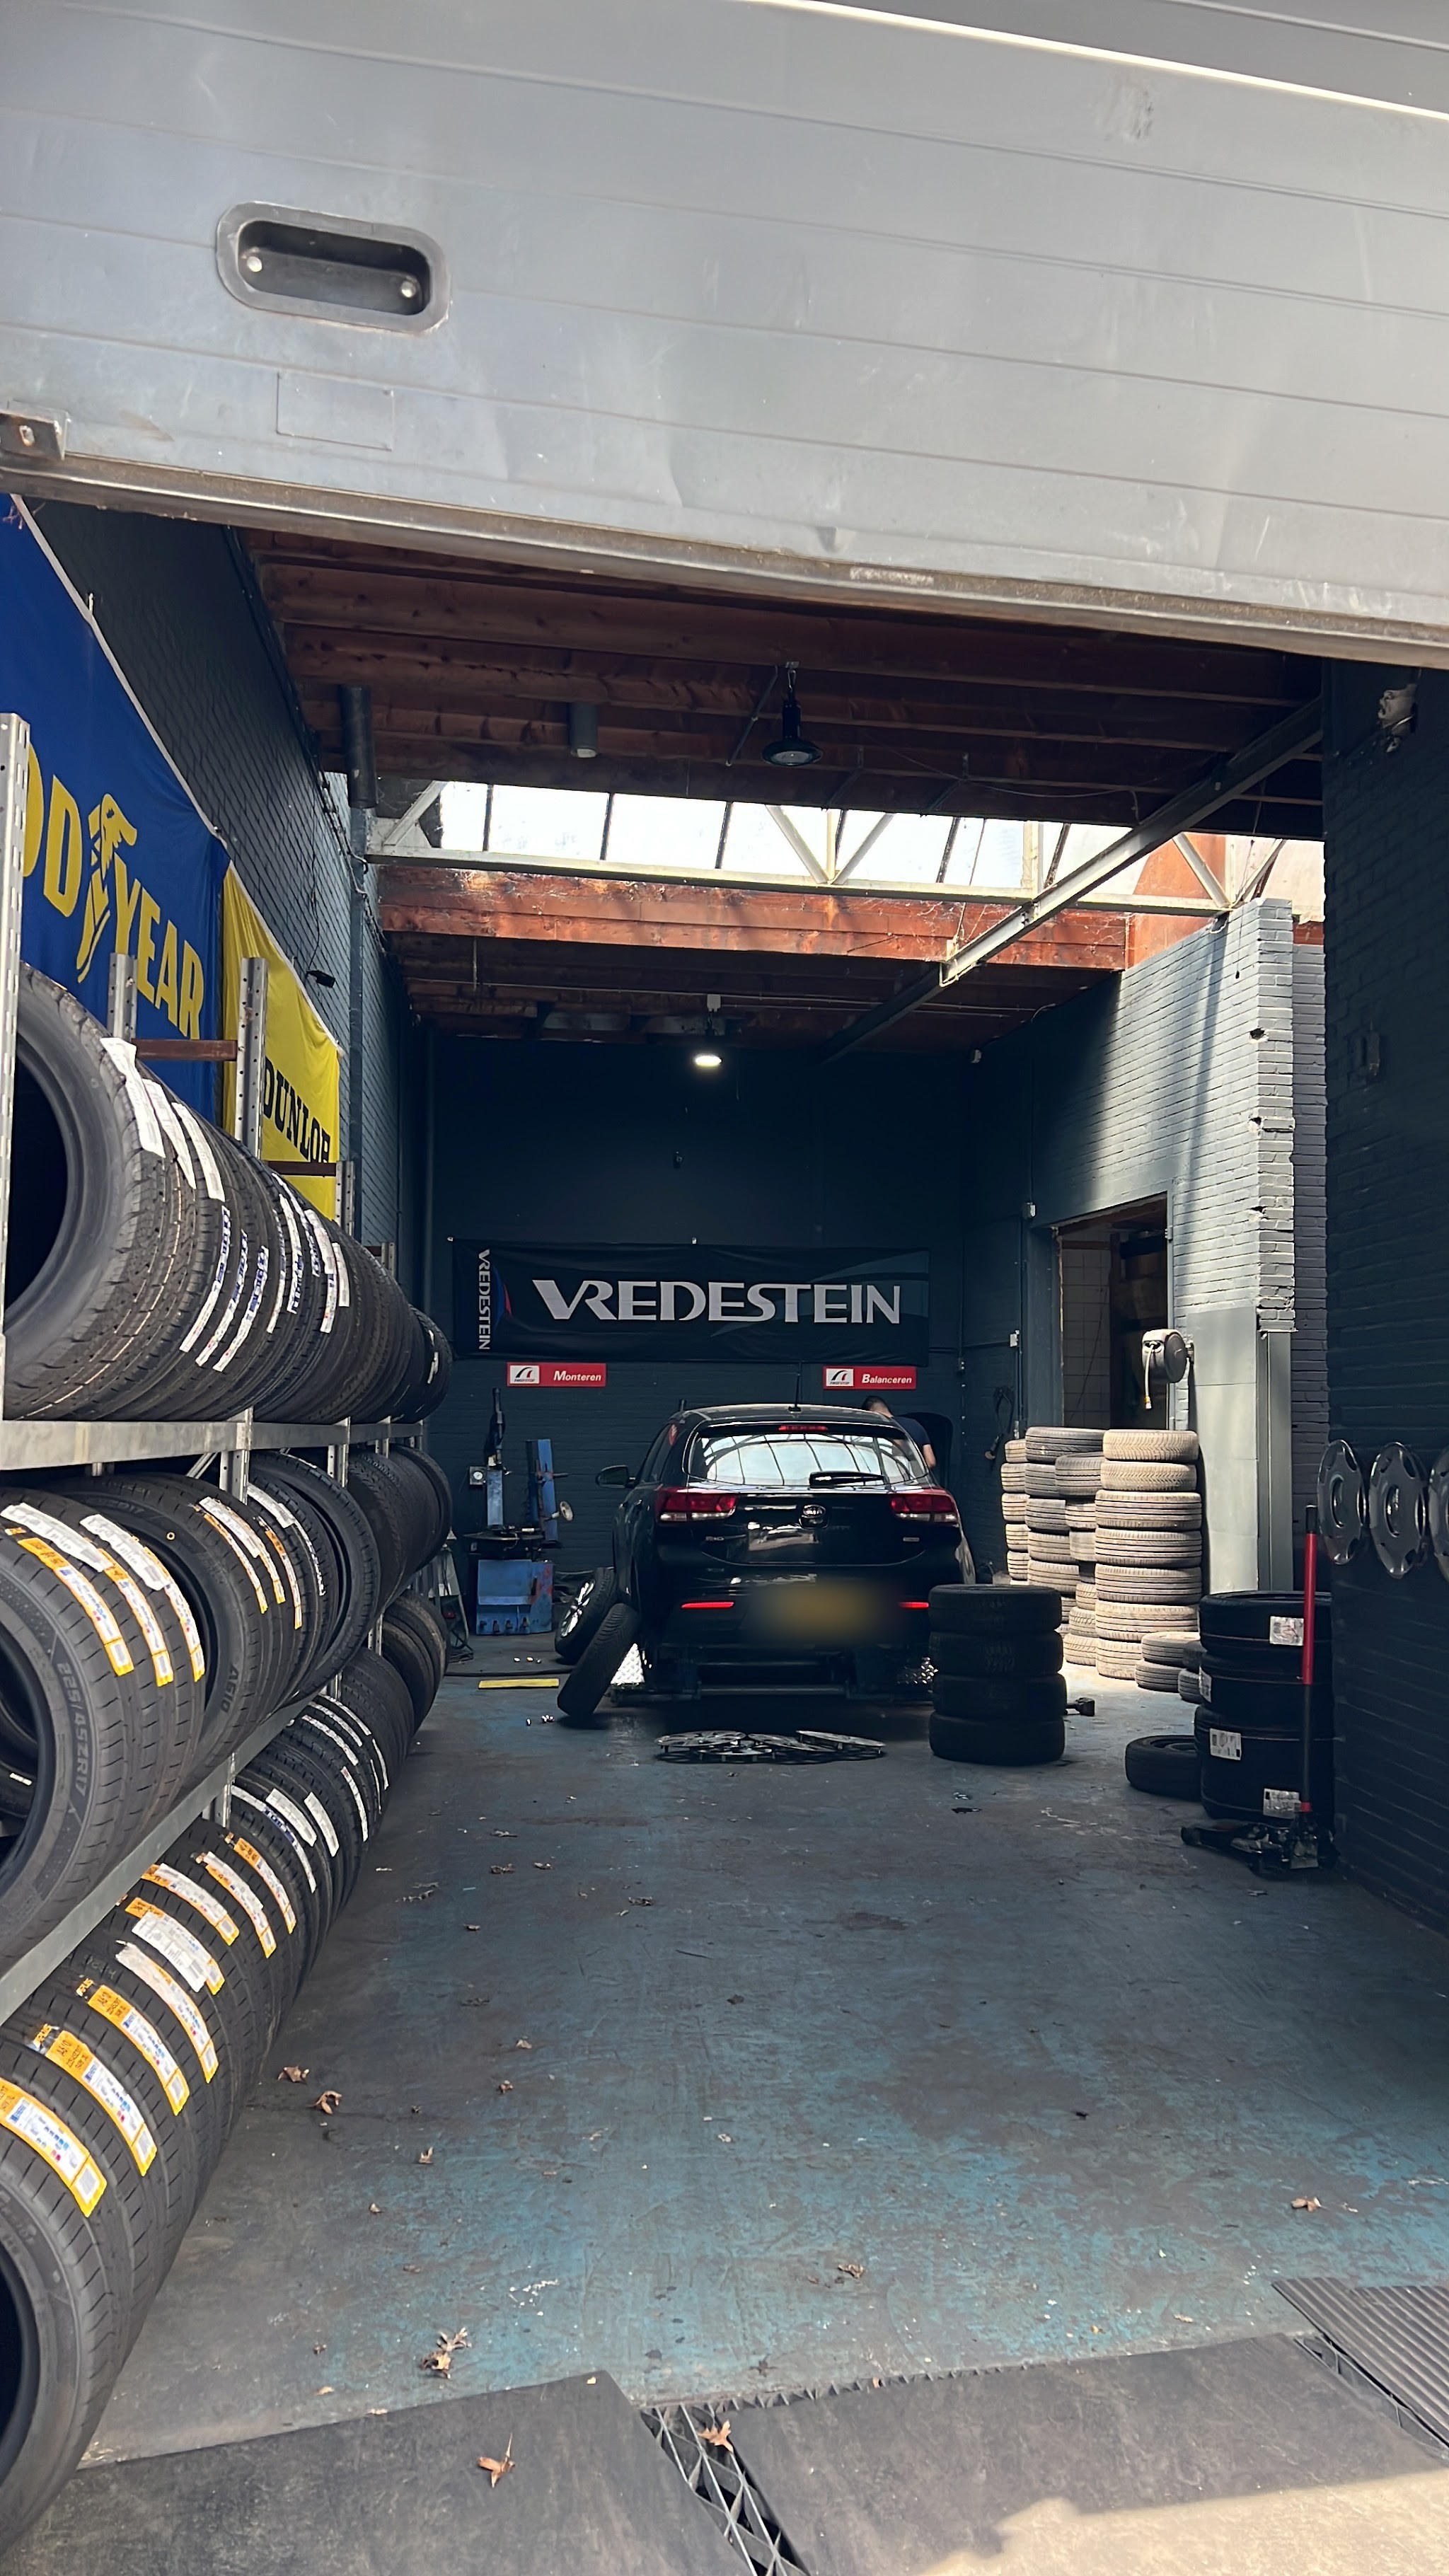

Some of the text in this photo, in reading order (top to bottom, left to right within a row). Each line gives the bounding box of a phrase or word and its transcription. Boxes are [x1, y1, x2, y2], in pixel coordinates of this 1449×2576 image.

[263, 1056, 330, 1163] DUNLOP
[478, 1249, 491, 1350] VREDESTEIN
[531, 1279, 901, 1324] VREDESTEIN
[553, 1370, 601, 1381] Monteren
[862, 1373, 913, 1384] Balanceren
[57, 1662, 89, 1796] 225/45ZR17
